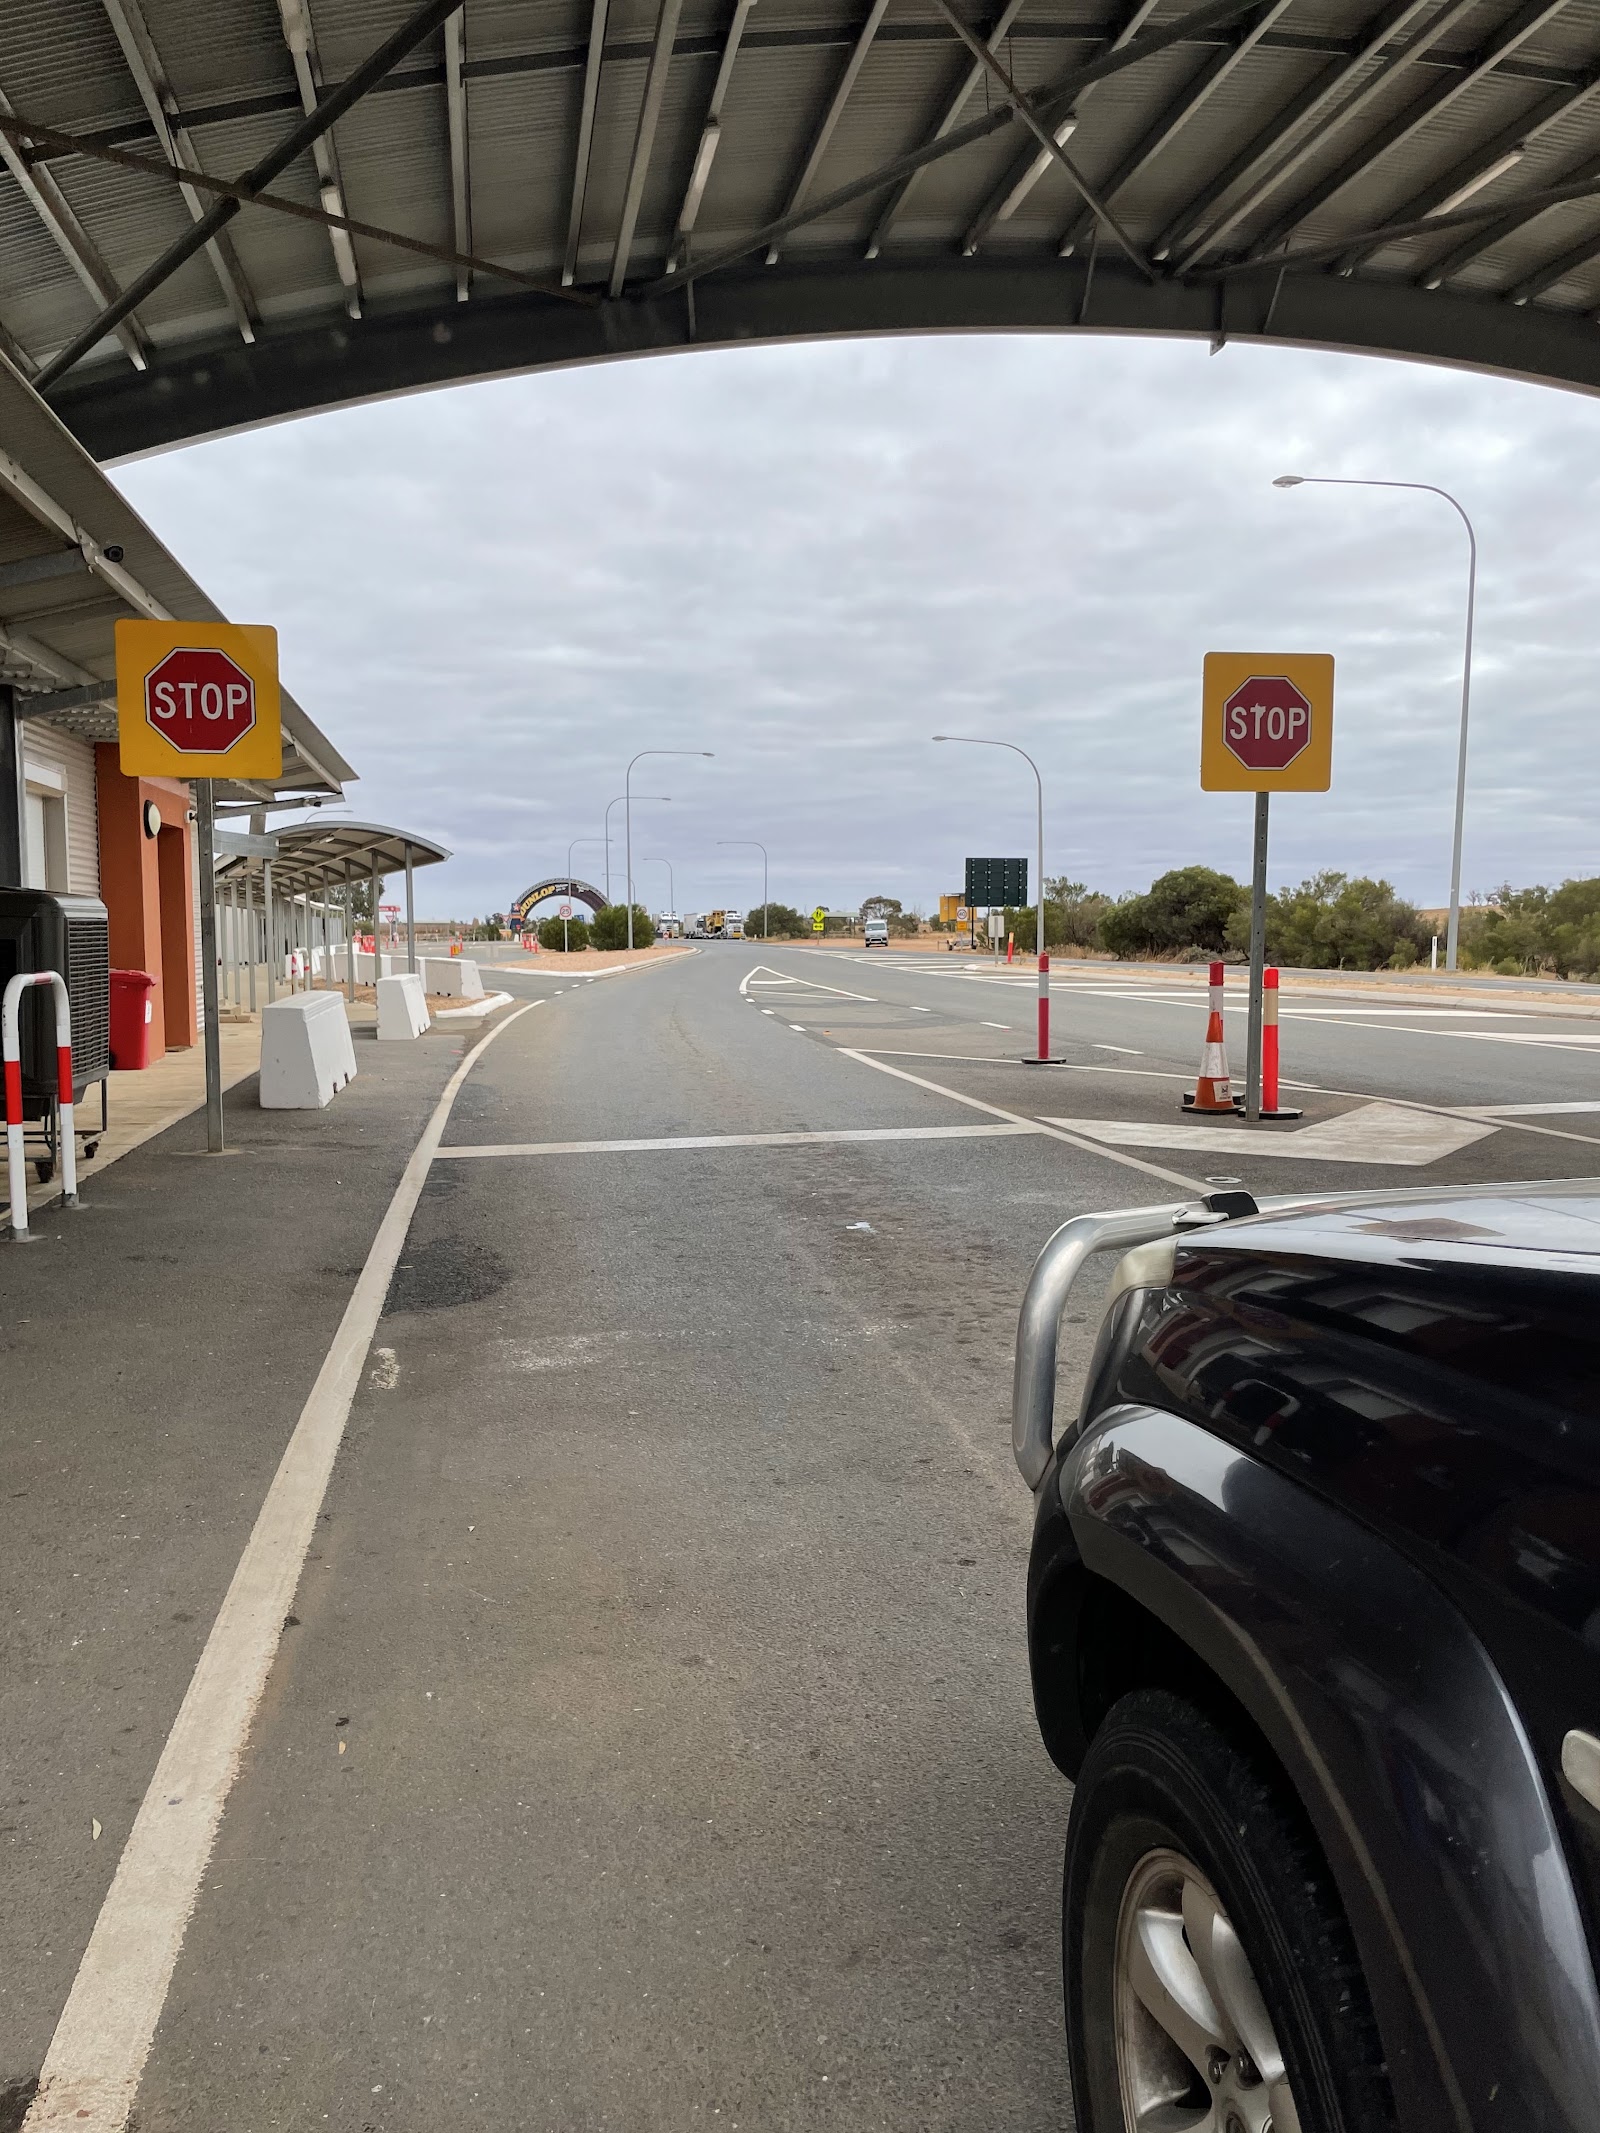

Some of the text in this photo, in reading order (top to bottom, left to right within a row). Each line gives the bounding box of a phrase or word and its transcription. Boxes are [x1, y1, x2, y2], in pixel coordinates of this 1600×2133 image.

[154, 681, 248, 720] STOP
[1229, 704, 1306, 740] STOP
[520, 885, 556, 917] DUNLOP
